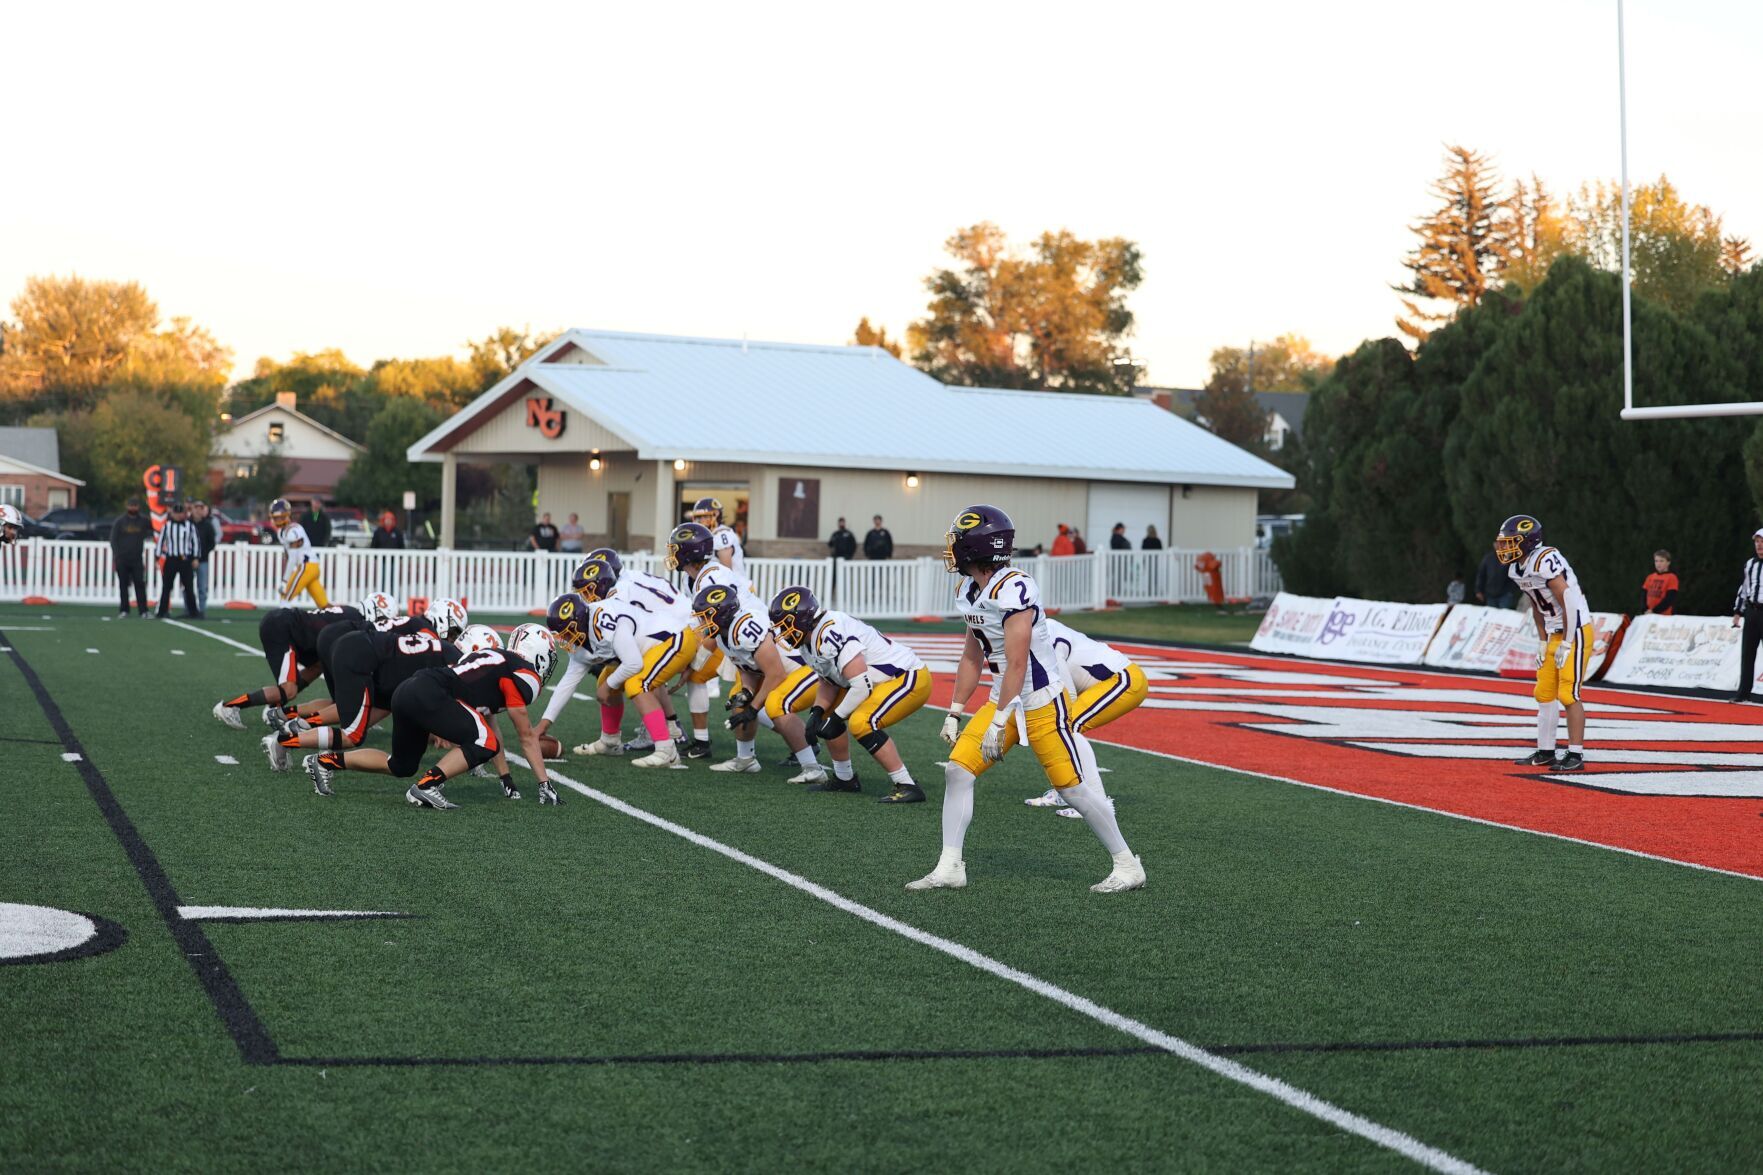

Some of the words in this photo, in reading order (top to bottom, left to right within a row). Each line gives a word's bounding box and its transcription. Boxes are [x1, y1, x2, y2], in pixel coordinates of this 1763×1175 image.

[165, 468, 176, 491] 1
[956, 512, 982, 530] G
[1516, 520, 1534, 532] G
[676, 529, 694, 541] G
[721, 534, 729, 545] 8
[583, 564, 600, 579] G
[1545, 554, 1562, 573] 24
[707, 589, 727, 604] G
[781, 592, 800, 611] G
[1014, 580, 1030, 605] 2
[558, 601, 574, 620] G
[600, 613, 619, 631] 62
[741, 620, 763, 642] 50
[824, 629, 845, 651] 74
